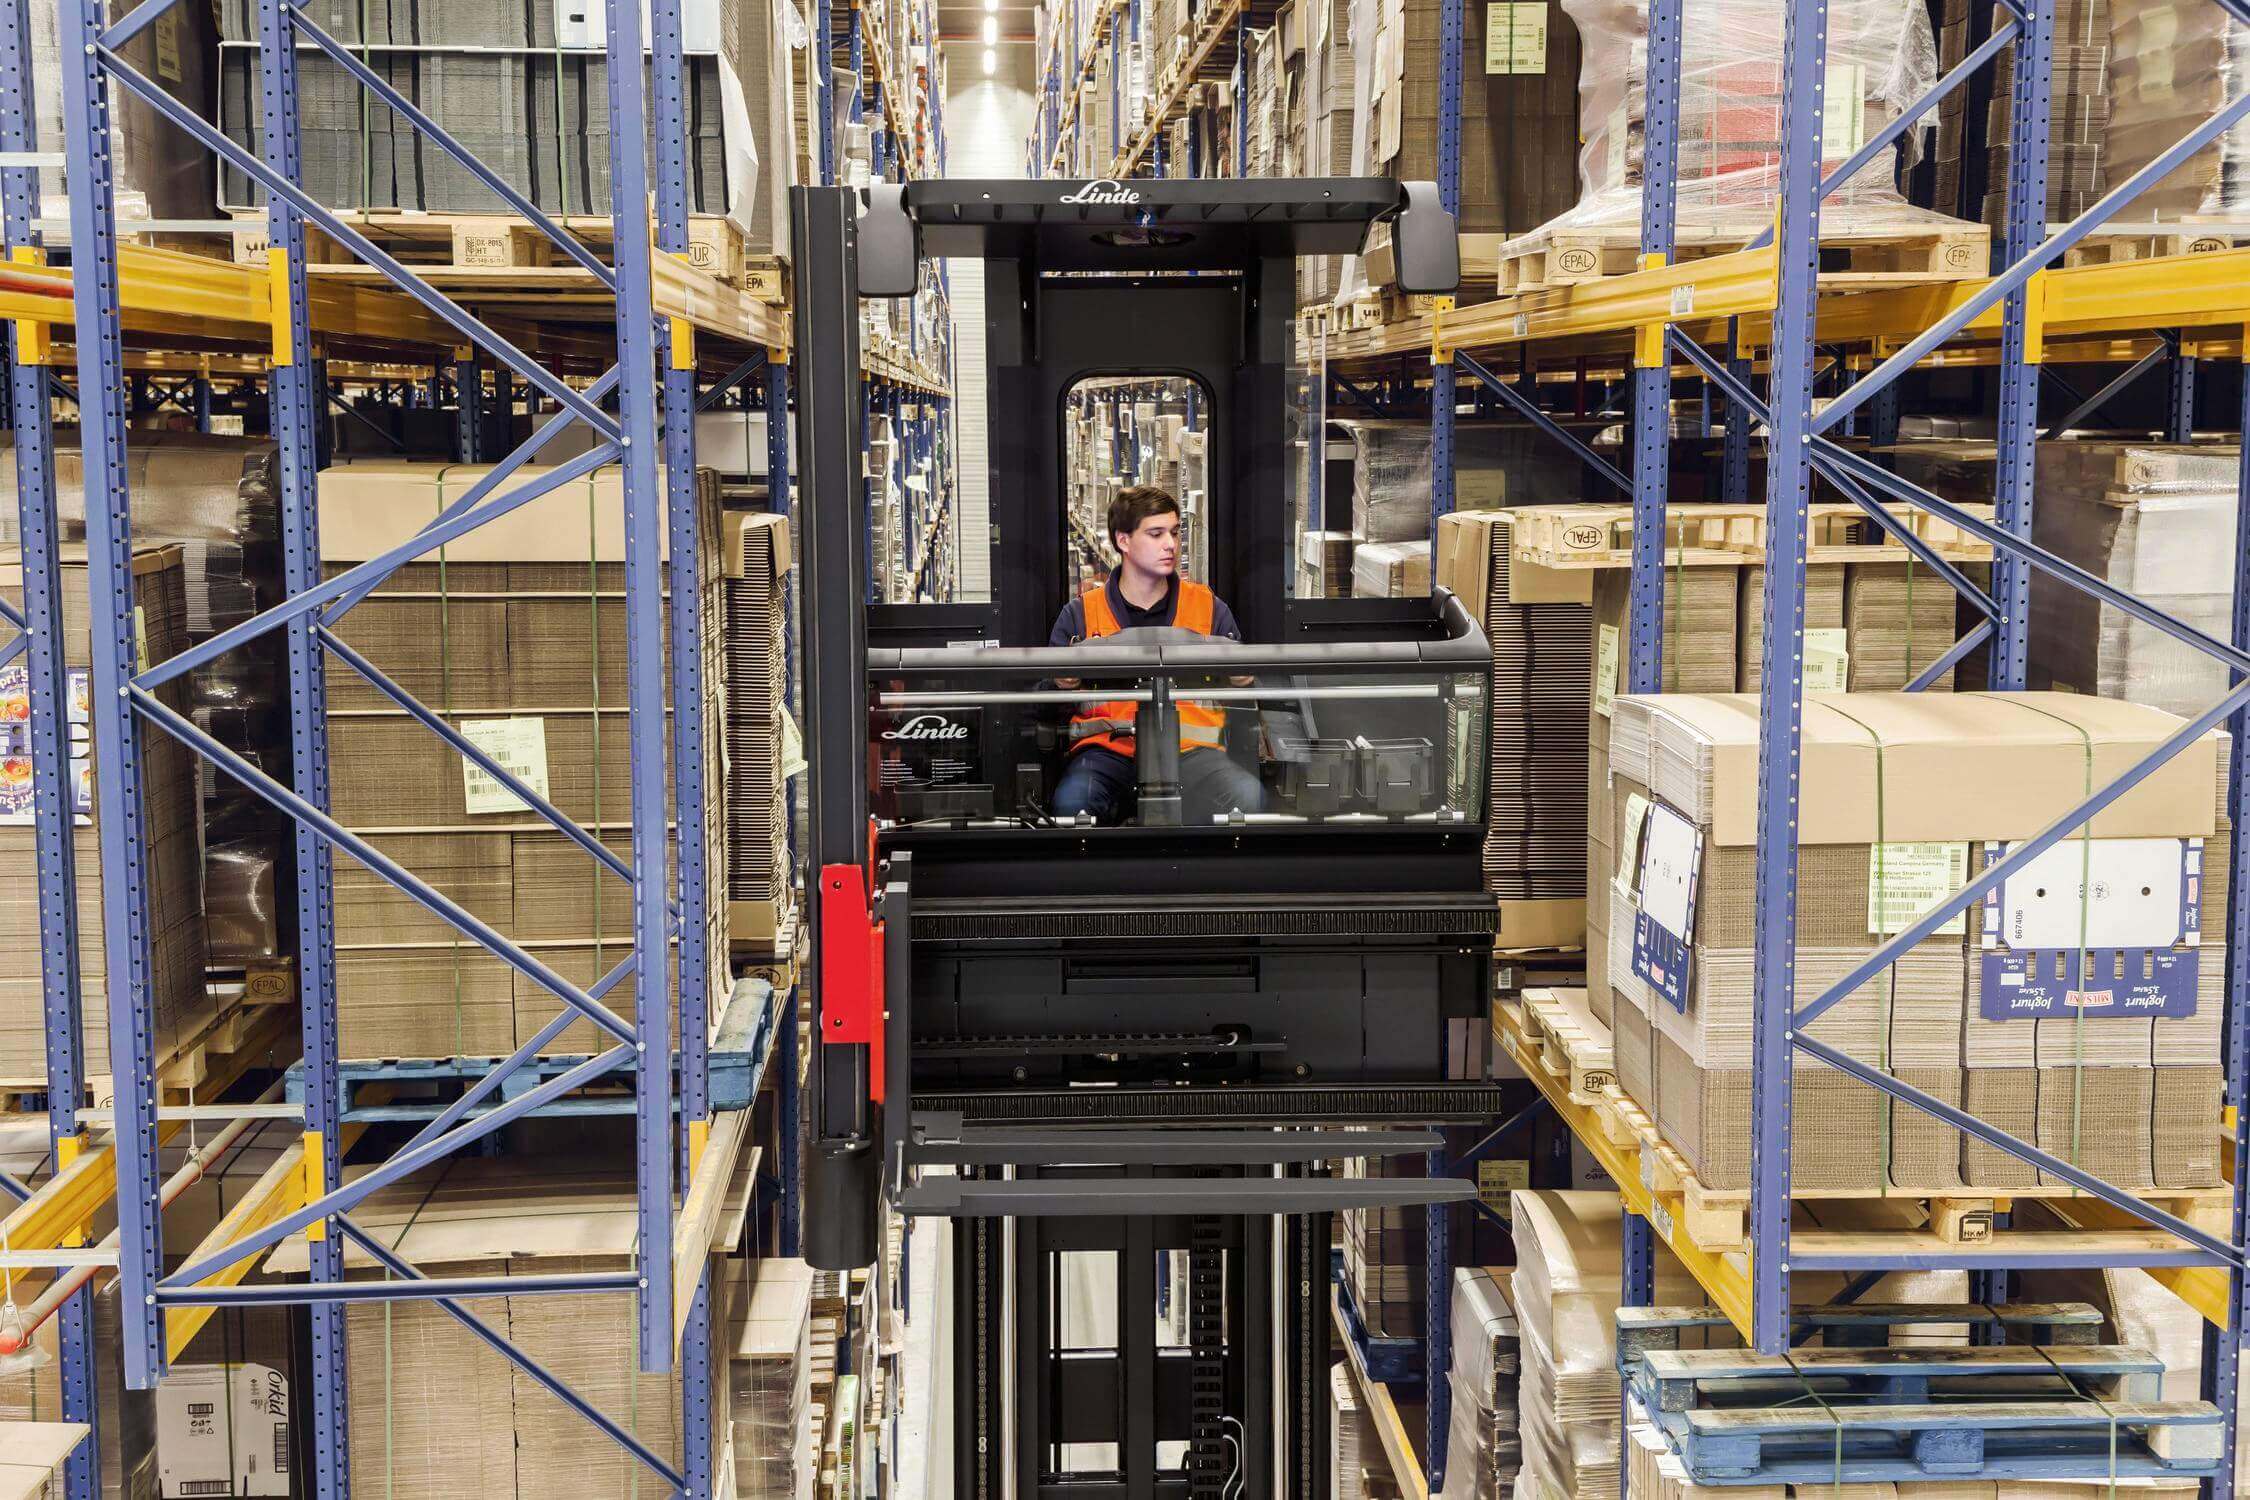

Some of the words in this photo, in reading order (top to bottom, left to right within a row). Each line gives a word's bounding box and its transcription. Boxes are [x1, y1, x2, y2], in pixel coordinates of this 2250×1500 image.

[1060, 180, 1140, 204] Linde
[690, 246, 709, 262] UR
[1564, 253, 1590, 268] EPAL
[1569, 530, 1597, 544] EPAL
[880, 715, 968, 739] Linde
[2014, 909, 2024, 940] 667406
[2010, 996, 2054, 1010] Joghurt
[2068, 993, 2109, 1004] MILSNI
[2125, 994, 2167, 1008] Joghurt
[267, 1371, 287, 1417] Orkid
